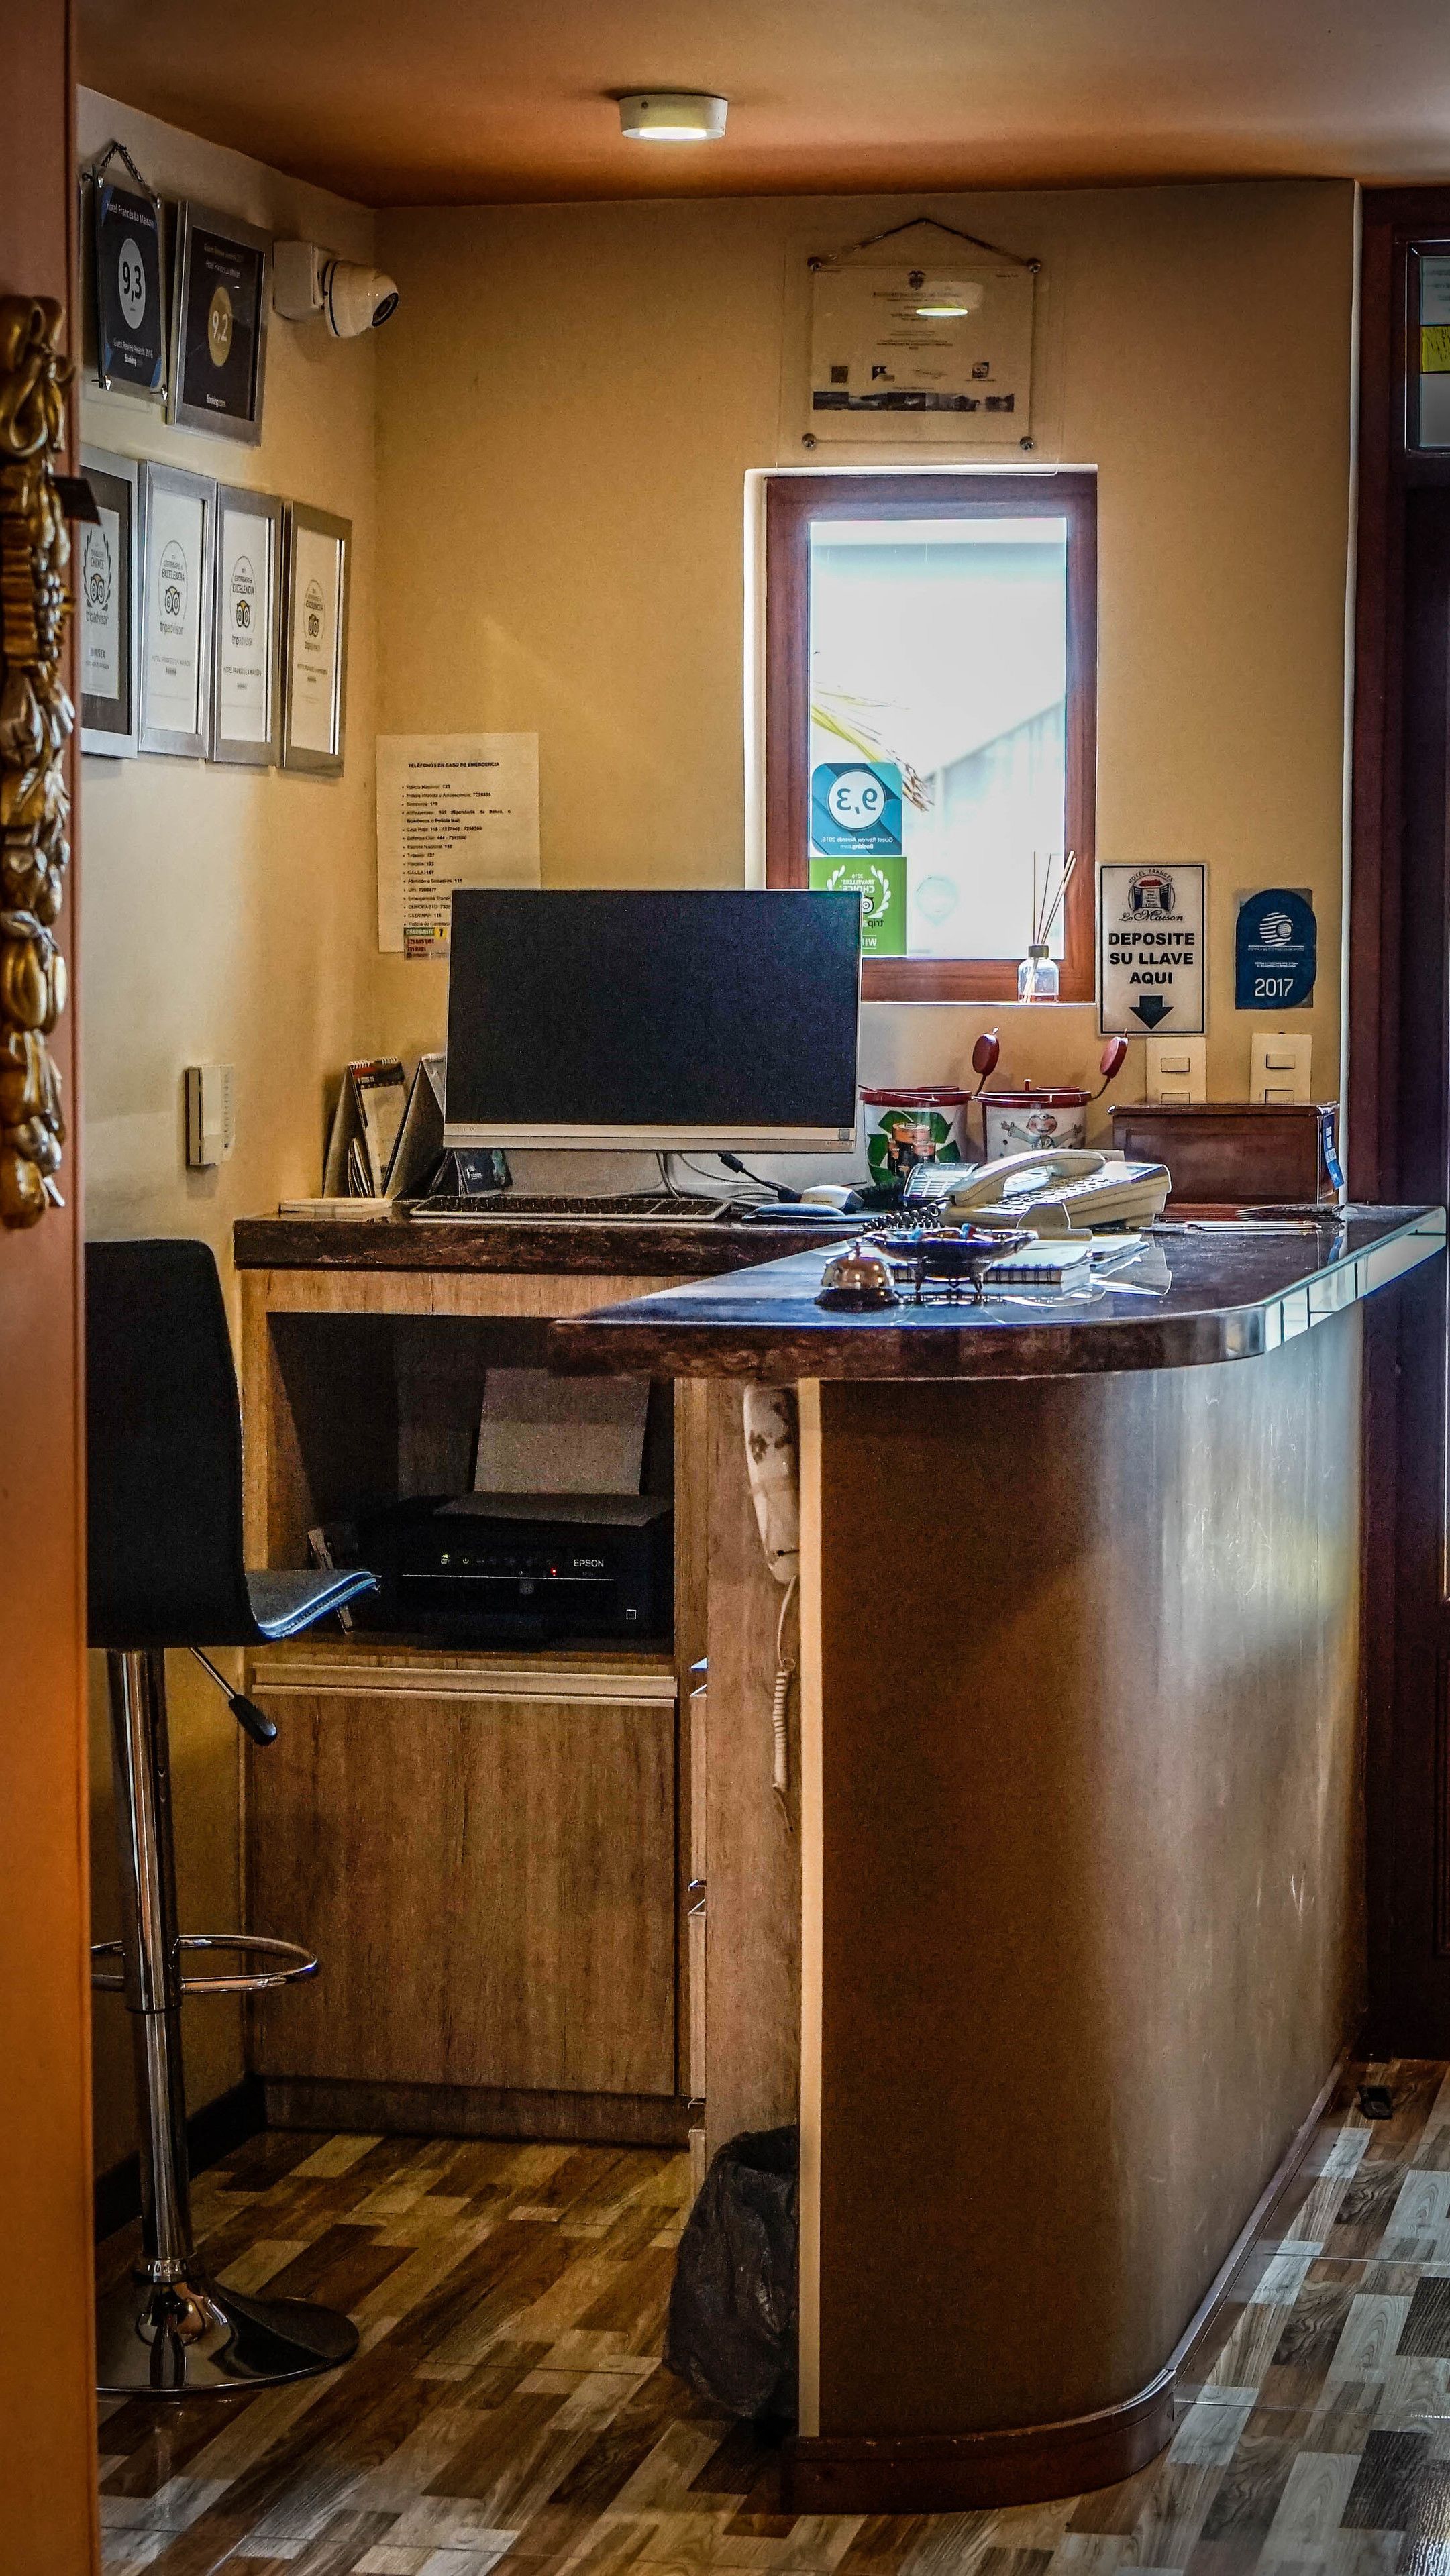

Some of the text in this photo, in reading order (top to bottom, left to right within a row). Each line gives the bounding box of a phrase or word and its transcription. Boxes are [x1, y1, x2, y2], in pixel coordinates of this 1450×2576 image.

[134, 211, 139, 222] La
[122, 260, 142, 303] 9,3
[213, 311, 228, 343] 9,2
[1128, 870, 1146, 885] HOTEL
[1119, 909, 1184, 922] La Maison
[439, 928, 444, 937] 1
[1108, 933, 1195, 945] DEPOSITE
[1109, 953, 1194, 965] SU LLAVE
[1129, 972, 1173, 985] AQUI
[1254, 977, 1294, 997] 2017
[573, 1558, 605, 1568] EPSON
